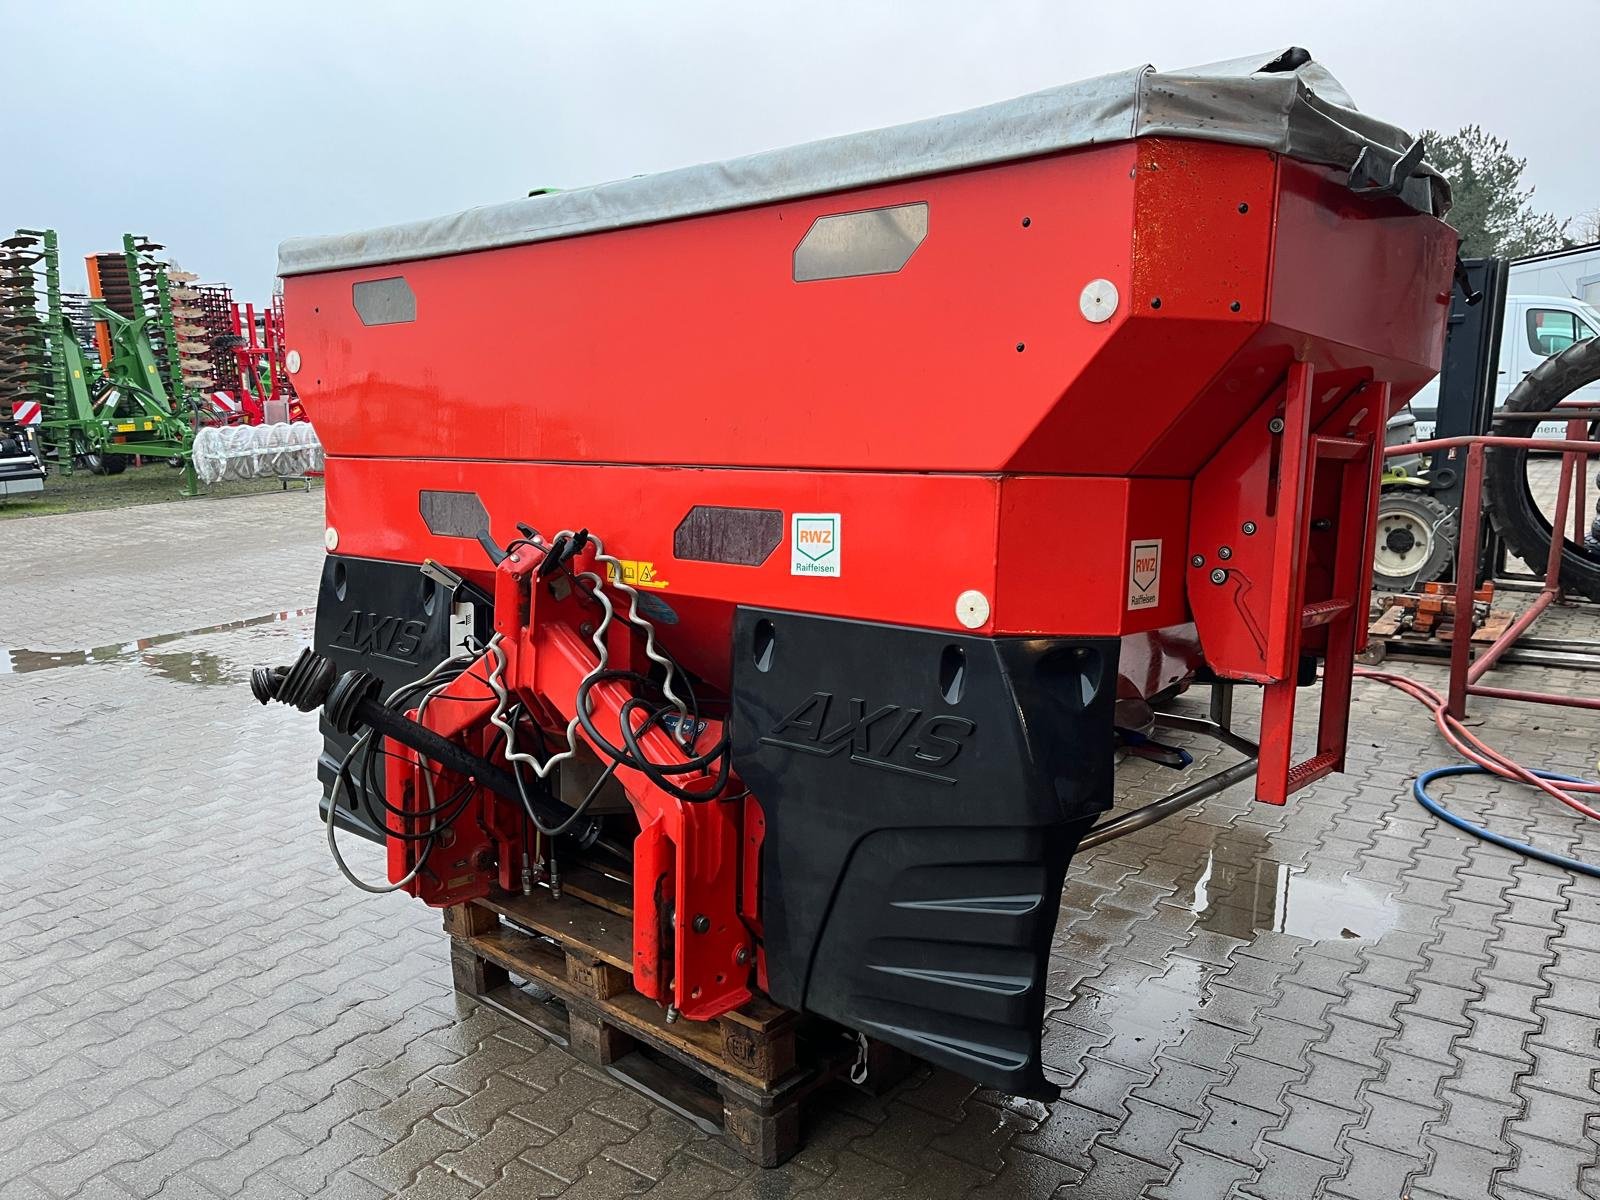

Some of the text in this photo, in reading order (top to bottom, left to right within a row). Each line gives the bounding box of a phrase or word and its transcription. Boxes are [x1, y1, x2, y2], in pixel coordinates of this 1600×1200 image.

[800, 530, 831, 543] RWZ
[796, 563, 835, 573] Raiffeisen
[1136, 558, 1156, 573] RWZ
[1131, 594, 1156, 605] Raiffeisen
[334, 610, 427, 656] AXIS
[770, 690, 977, 768] AXIS
